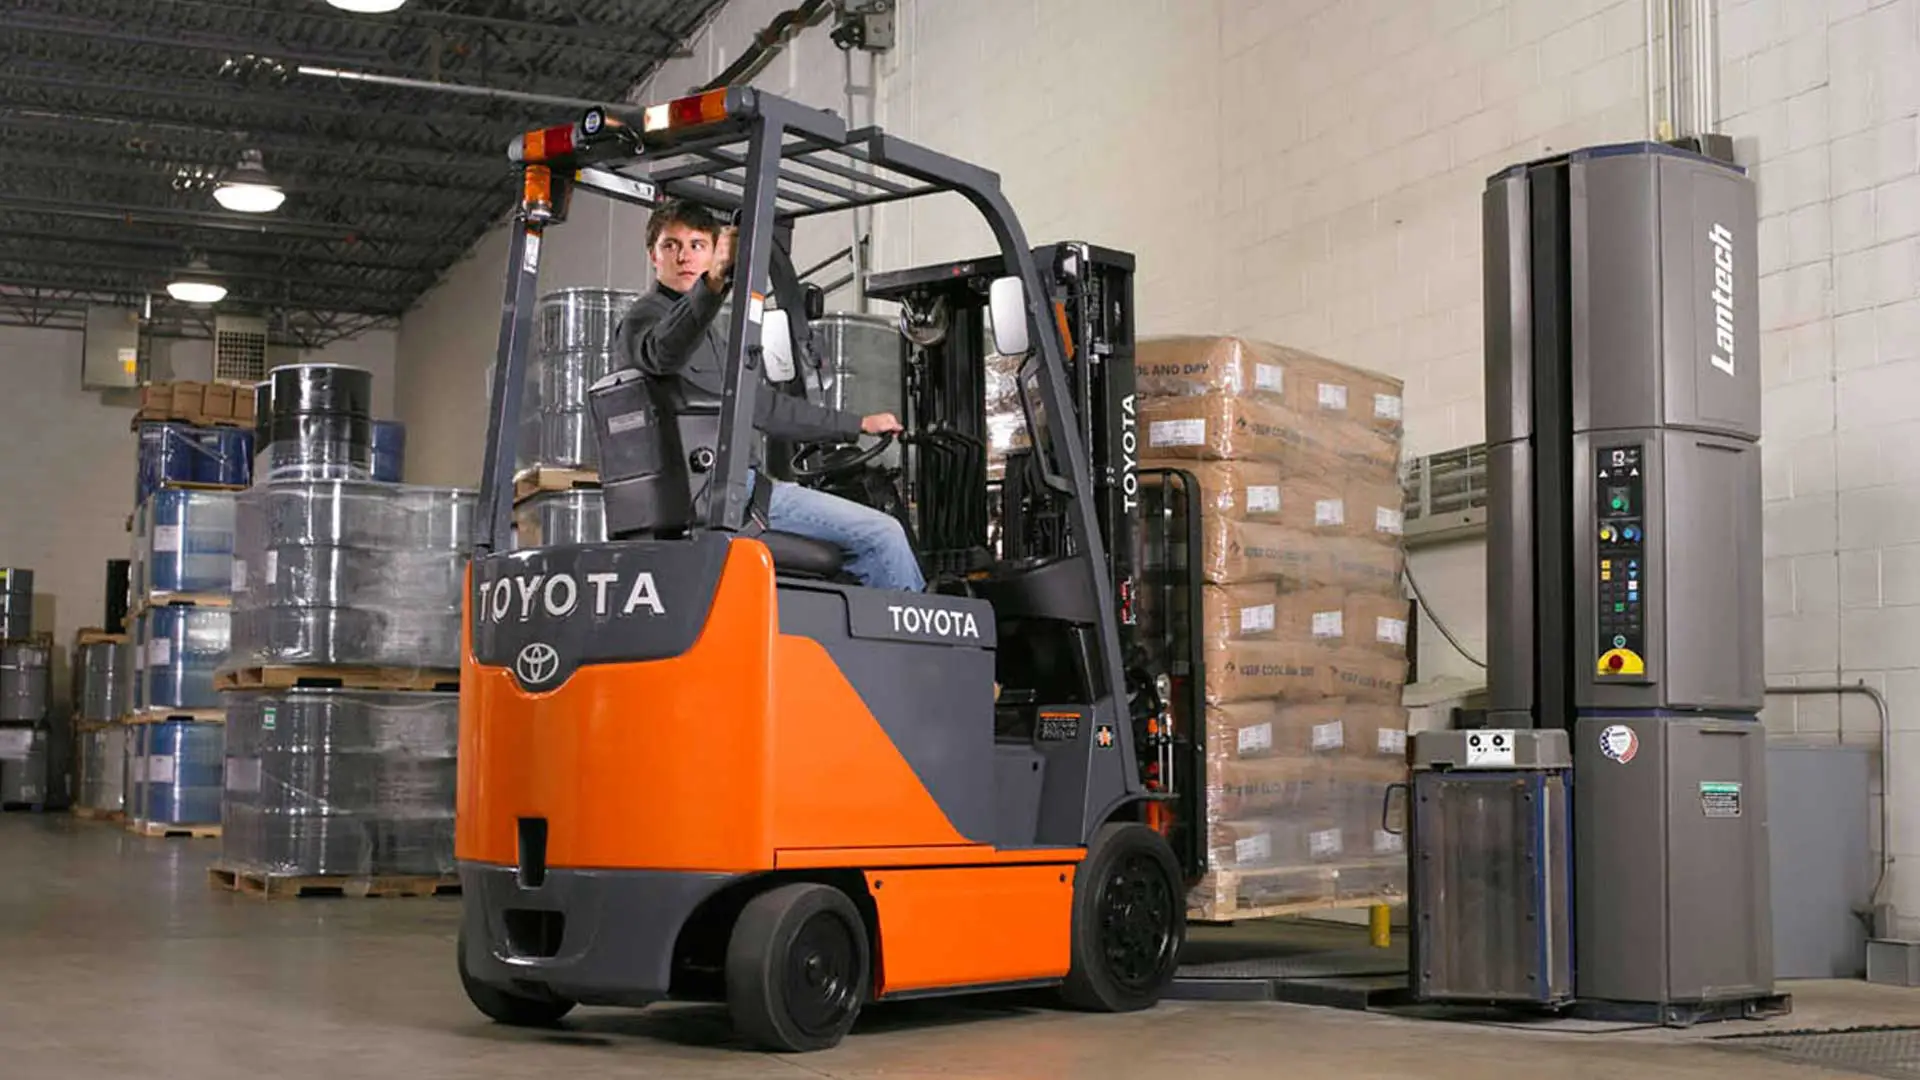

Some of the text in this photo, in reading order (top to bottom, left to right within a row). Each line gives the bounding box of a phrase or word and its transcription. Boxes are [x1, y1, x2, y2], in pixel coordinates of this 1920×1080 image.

[1709, 224, 1735, 376] Lantech
[1153, 364, 1180, 376] AND
[1122, 394, 1138, 513] TOYOTA
[480, 572, 665, 621] TOYOTA
[888, 606, 979, 638] TOYOTA
